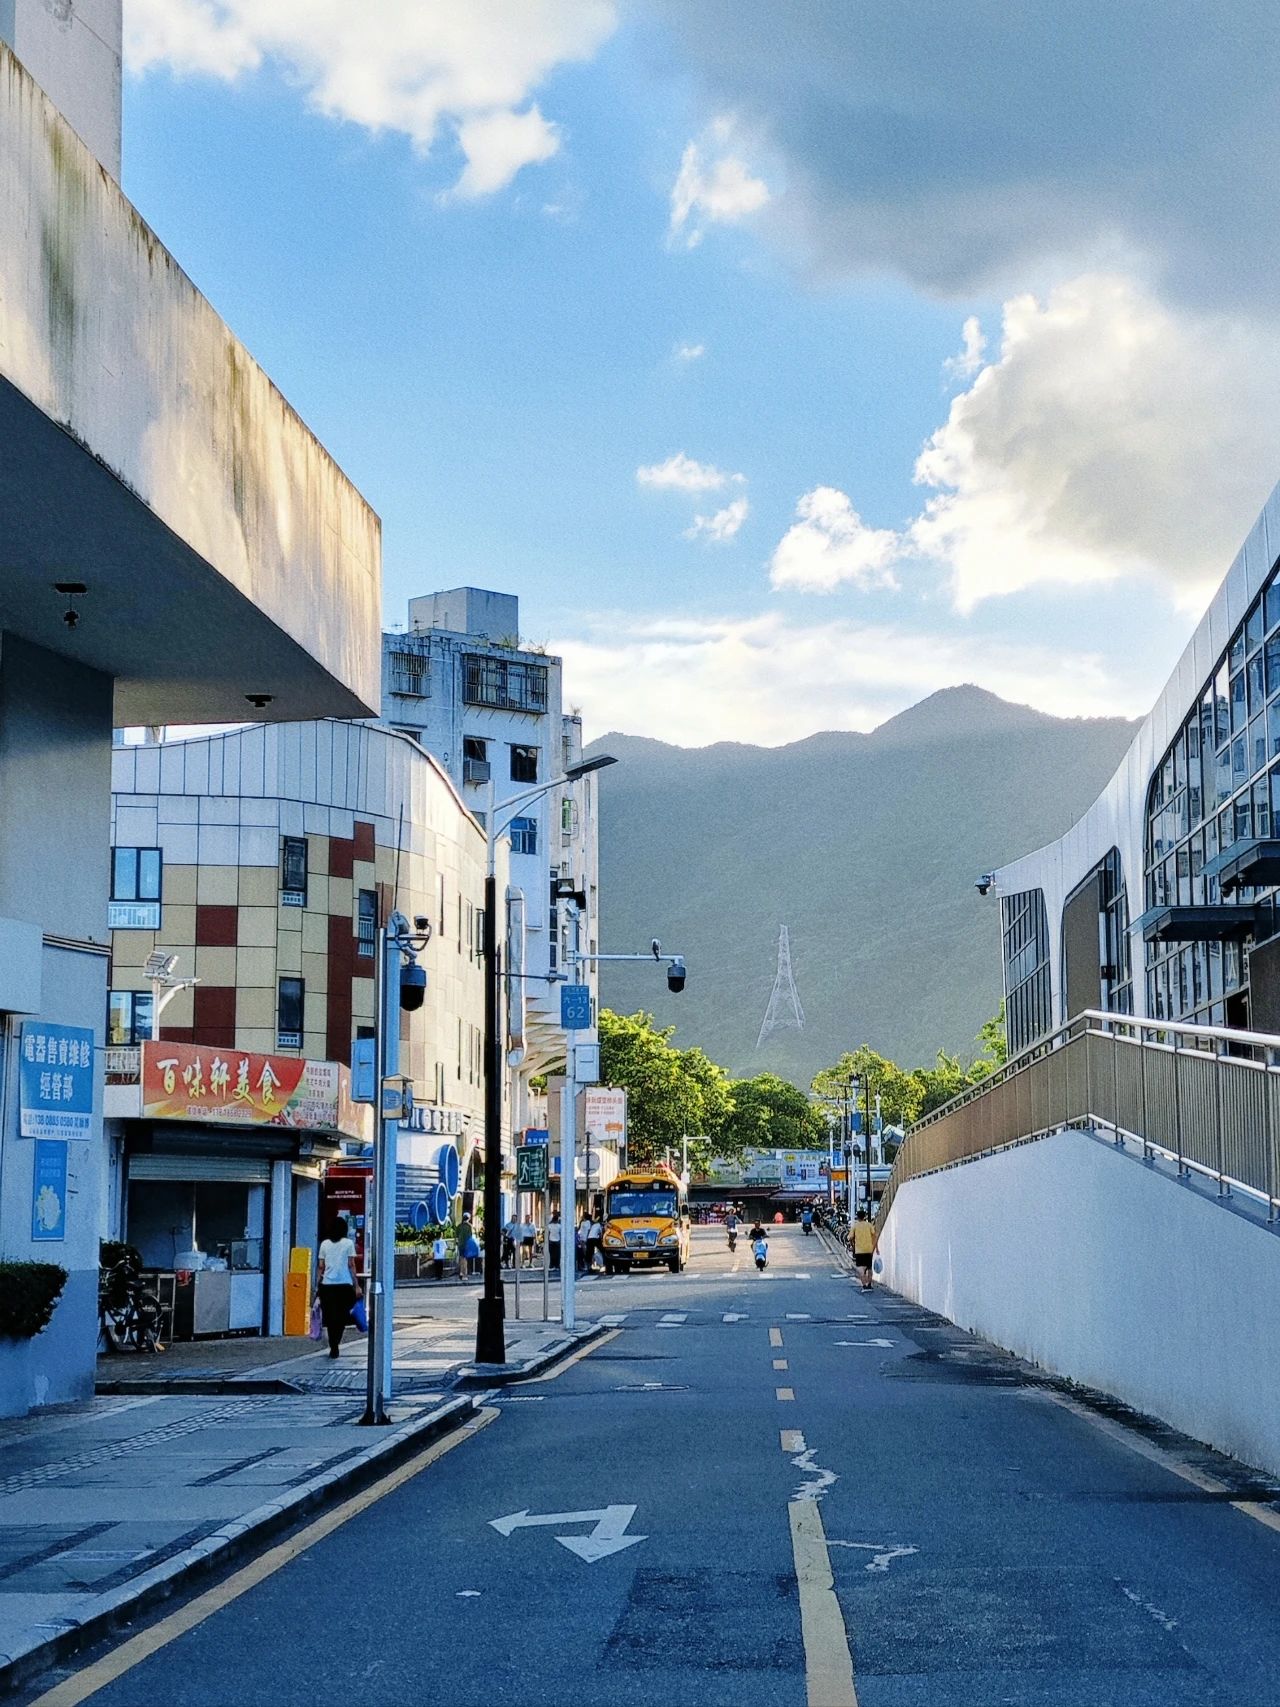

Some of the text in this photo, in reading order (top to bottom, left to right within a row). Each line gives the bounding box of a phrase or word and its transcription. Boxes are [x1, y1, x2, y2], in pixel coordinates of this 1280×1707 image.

[567, 1006, 585, 1019] 62
[39, 1072, 74, 1102] 經營部
